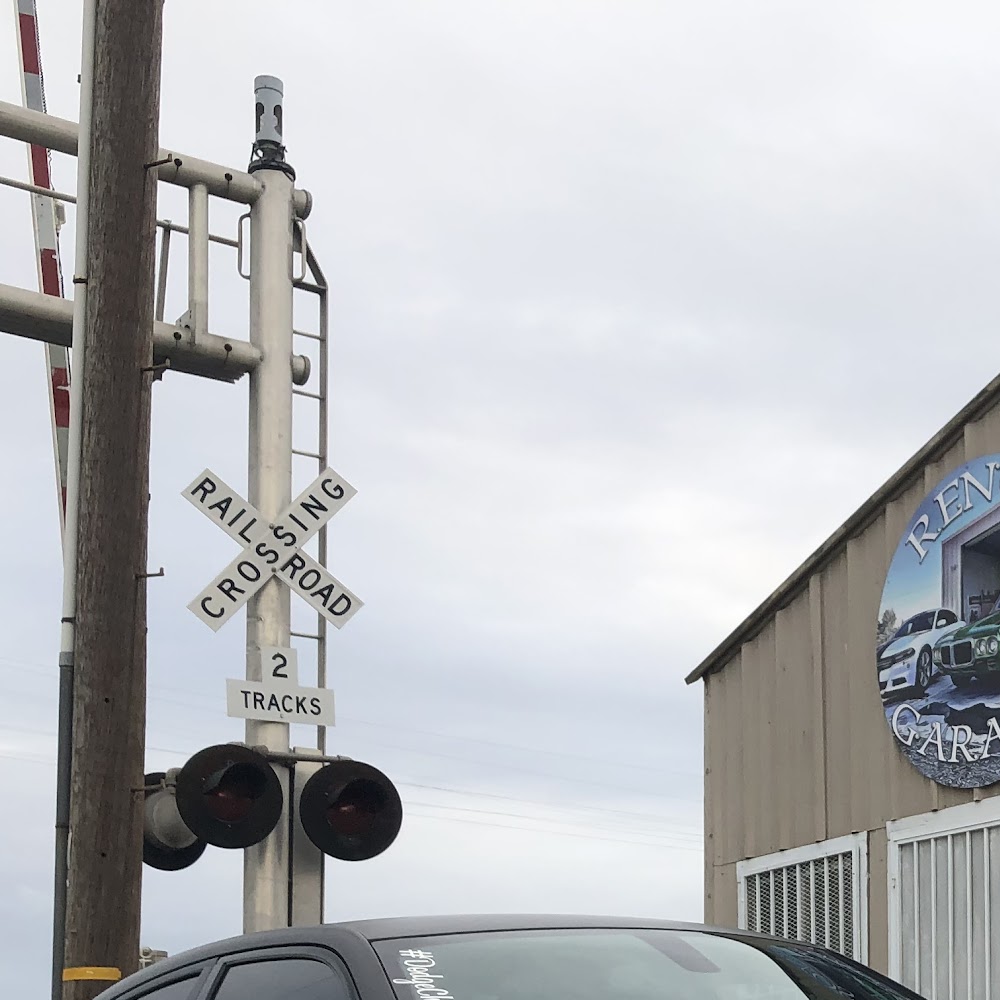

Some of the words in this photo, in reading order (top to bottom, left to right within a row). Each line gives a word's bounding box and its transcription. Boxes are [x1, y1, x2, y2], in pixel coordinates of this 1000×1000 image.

[190, 476, 257, 544] RAIL
[280, 552, 352, 617] ROAD
[200, 477, 345, 619] CROSSING
[240, 689, 322, 716] TRACKS
[271, 652, 288, 679] 2
